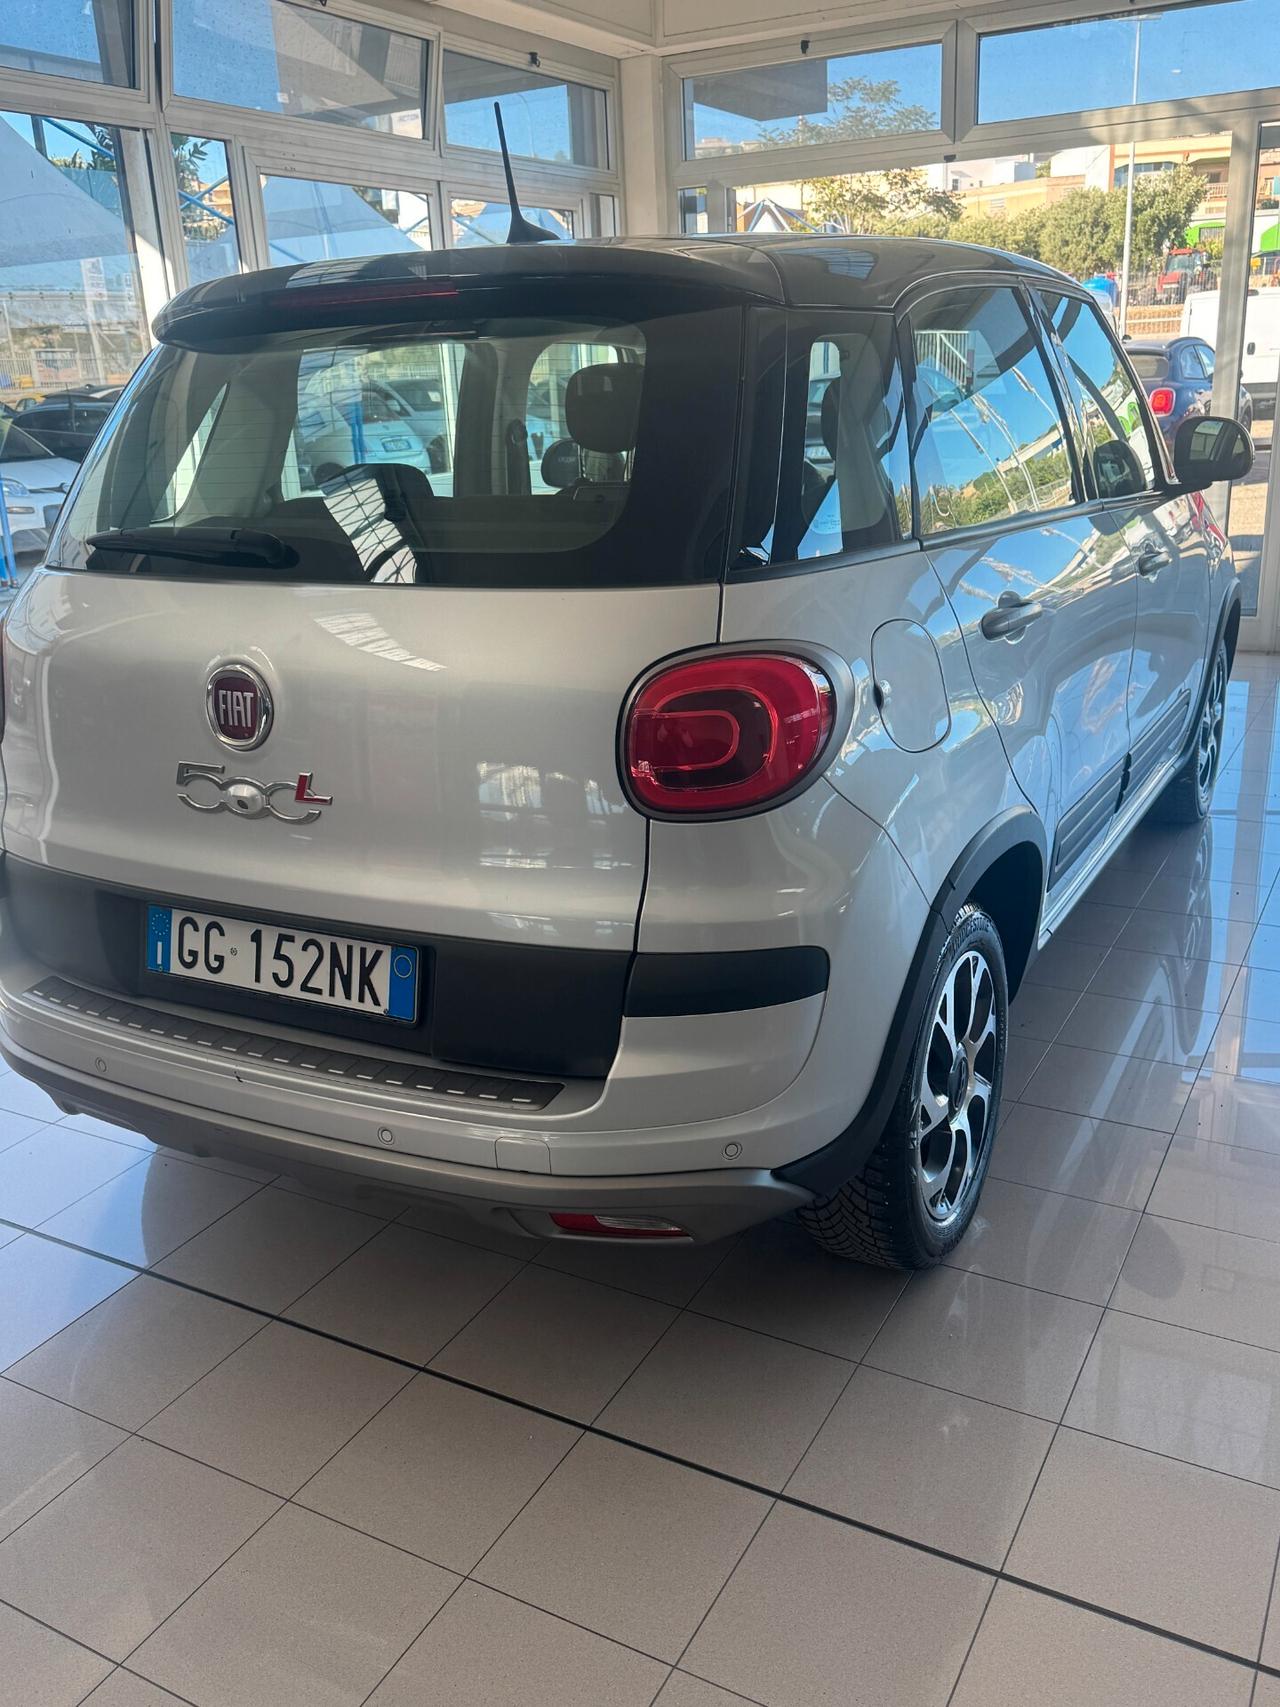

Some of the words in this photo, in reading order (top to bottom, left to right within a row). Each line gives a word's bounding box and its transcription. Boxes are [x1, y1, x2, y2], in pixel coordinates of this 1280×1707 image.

[218, 689, 254, 728] FIAT
[177, 916, 226, 975] GG
[250, 928, 384, 1007] 152NK
